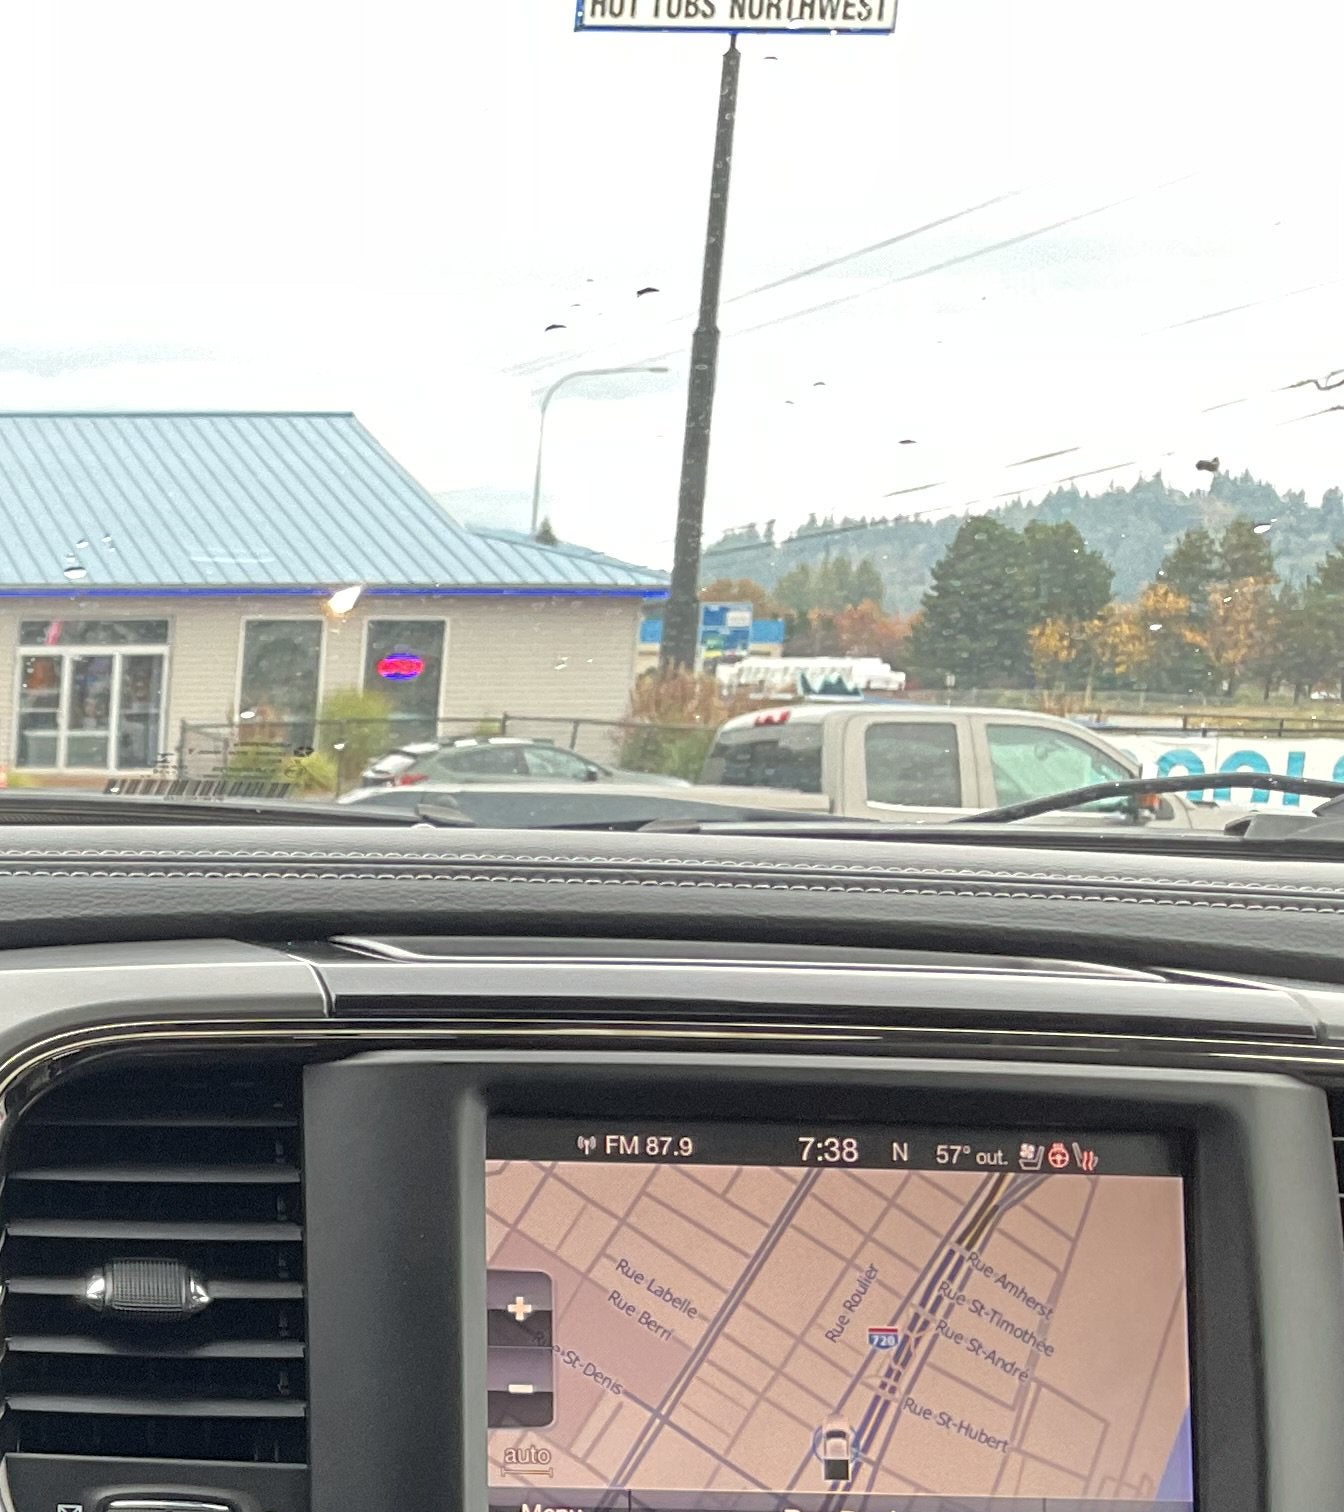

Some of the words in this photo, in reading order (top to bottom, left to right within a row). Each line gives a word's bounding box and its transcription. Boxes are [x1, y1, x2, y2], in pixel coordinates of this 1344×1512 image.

[590, 0, 638, 19] HOT
[605, 1135, 639, 1155] FM
[645, 1136, 694, 1157] 87.9
[798, 1137, 859, 1163] 7:38
[892, 1142, 909, 1162] N
[976, 1150, 1008, 1166] out.
[615, 1259, 645, 1286] Rue
[646, 1278, 699, 1319] Labelle
[825, 1314, 852, 1344] Rue
[844, 1262, 879, 1313] Roulier
[939, 1280, 967, 1307] Rue
[966, 1251, 995, 1278] Rue
[994, 1272, 1055, 1321] Amherst
[608, 1290, 636, 1317] Rue
[637, 1311, 674, 1343] Berri
[936, 1319, 964, 1346] Rue
[968, 1338, 1030, 1383] St-André
[562, 1350, 625, 1396] St-Denis
[902, 1397, 931, 1421] Rue
[937, 1411, 1010, 1454] St-Hubert
[504, 1446, 550, 1465] auto
